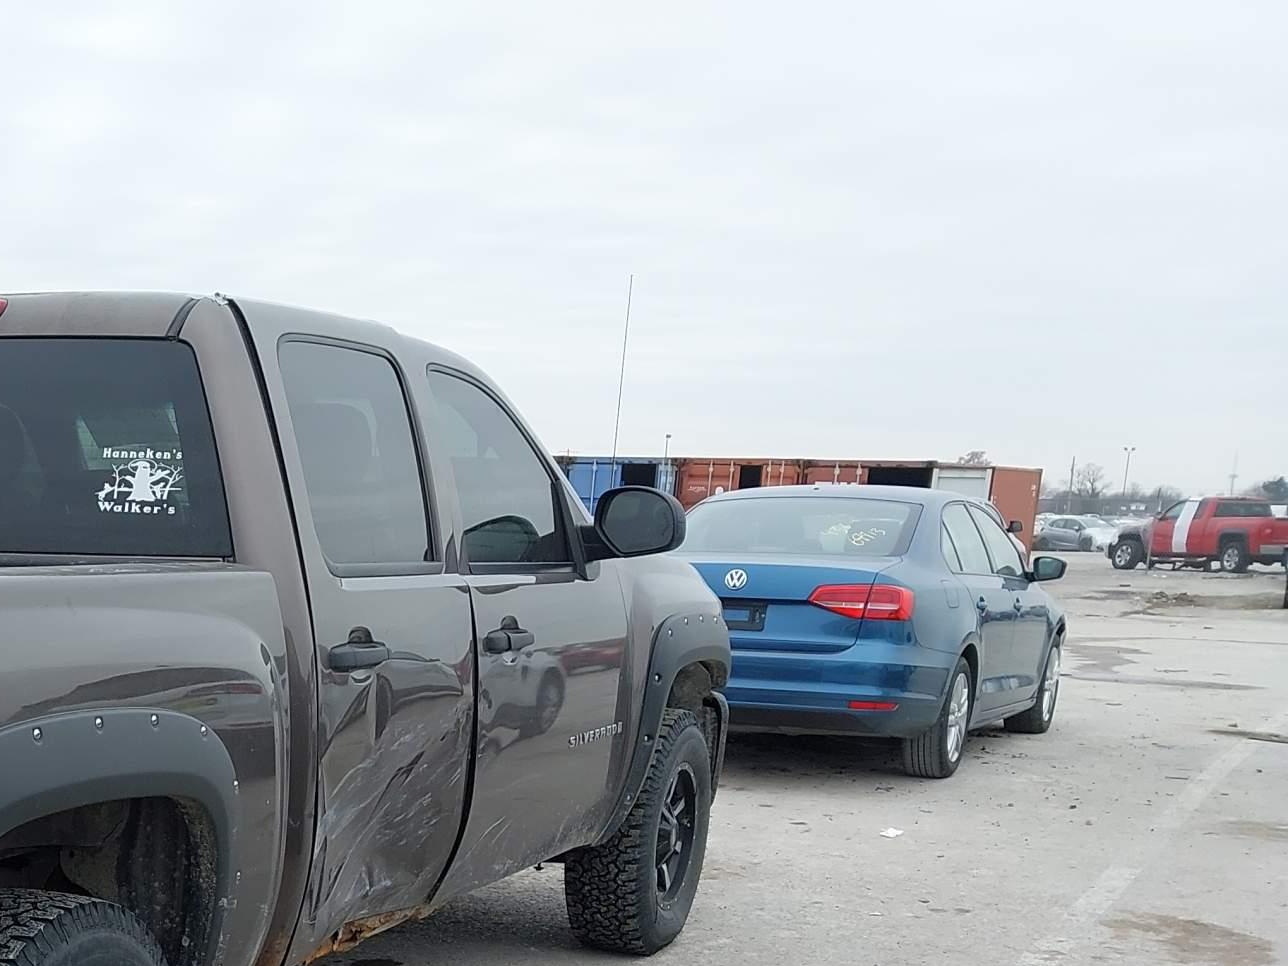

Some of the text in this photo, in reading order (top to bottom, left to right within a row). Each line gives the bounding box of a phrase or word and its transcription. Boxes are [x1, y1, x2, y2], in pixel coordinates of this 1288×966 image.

[103, 447, 183, 459] Hanneken's
[98, 501, 176, 515] Walker's
[569, 721, 623, 748] SILVERADO
